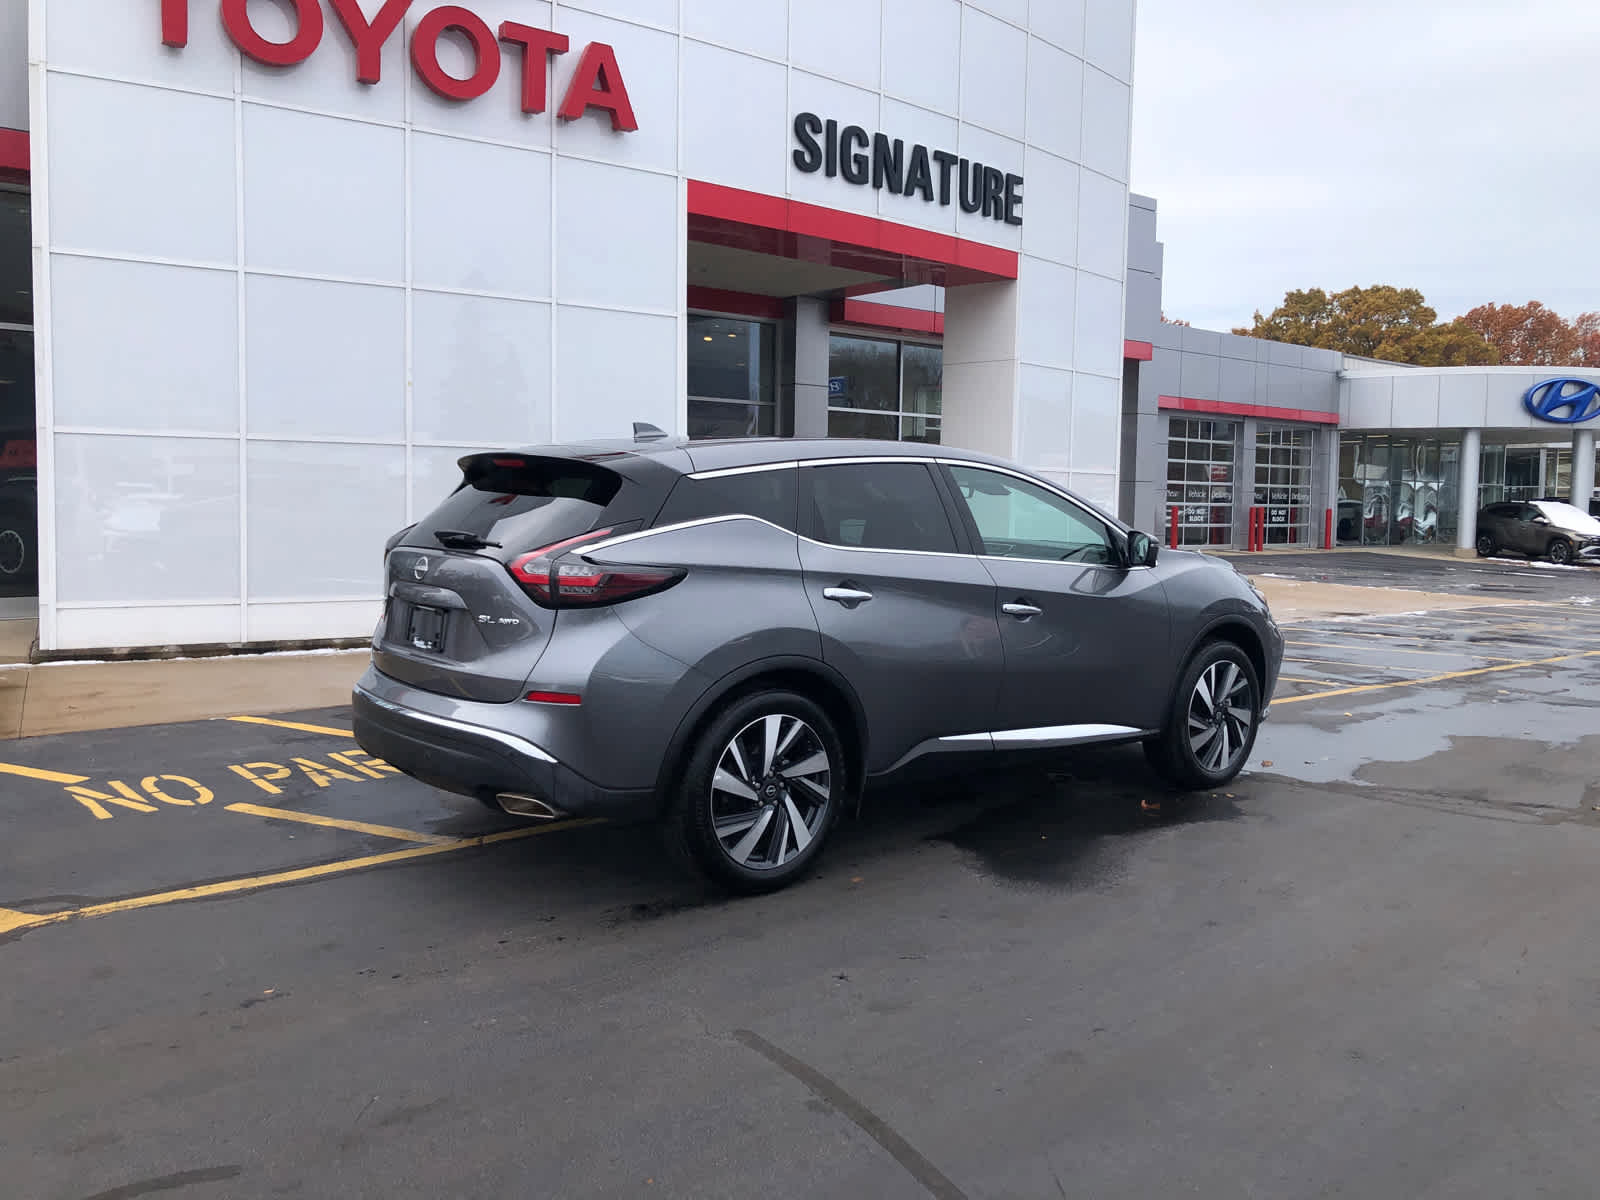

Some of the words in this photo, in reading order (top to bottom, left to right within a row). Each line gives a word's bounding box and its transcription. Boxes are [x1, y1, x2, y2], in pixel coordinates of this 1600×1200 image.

[793, 112, 1023, 225] SIGNATURE
[478, 614, 496, 624] SL
[64, 774, 214, 819] NO
